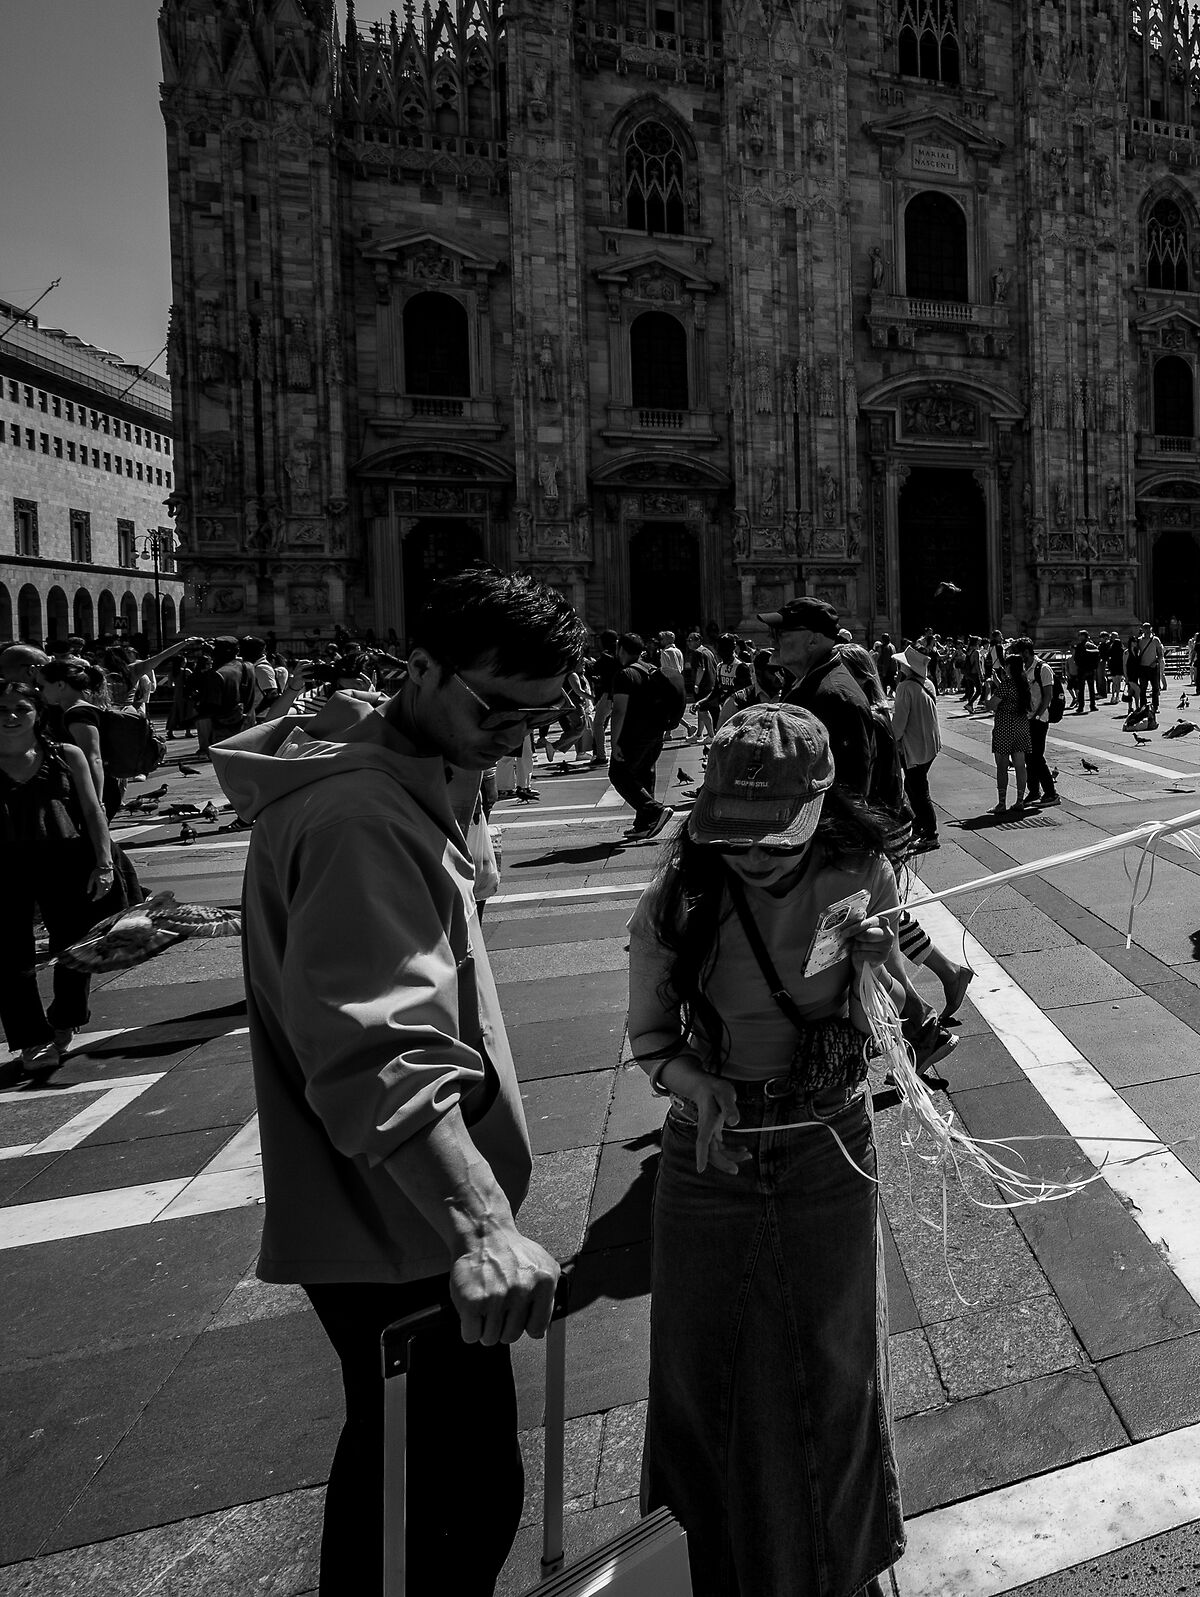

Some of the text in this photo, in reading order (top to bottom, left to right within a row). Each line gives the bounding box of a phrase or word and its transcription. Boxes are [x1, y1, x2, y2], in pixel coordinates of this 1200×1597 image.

[918, 149, 951, 160] MARIAE
[914, 158, 954, 170] NASCENTI
[721, 676, 736, 687] ORK
